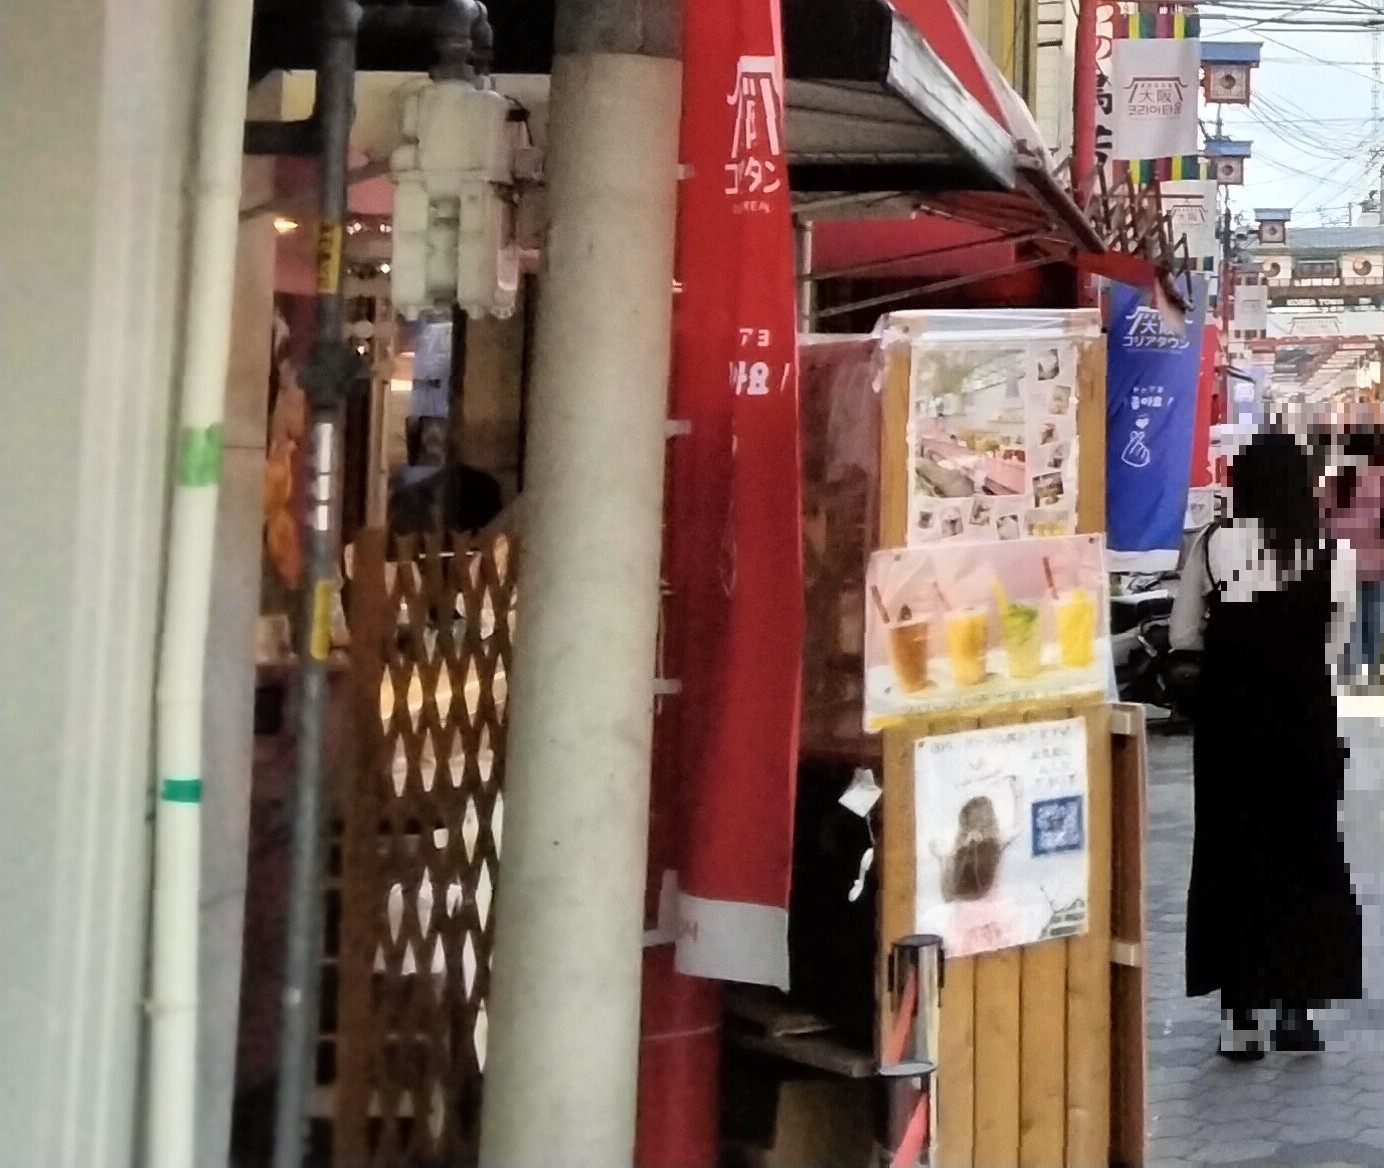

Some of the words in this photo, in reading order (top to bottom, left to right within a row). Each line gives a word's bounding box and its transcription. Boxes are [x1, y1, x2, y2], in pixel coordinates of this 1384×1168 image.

[1139, 88, 1172, 103] 大阪
[1122, 334, 1191, 350] コリアタウン
